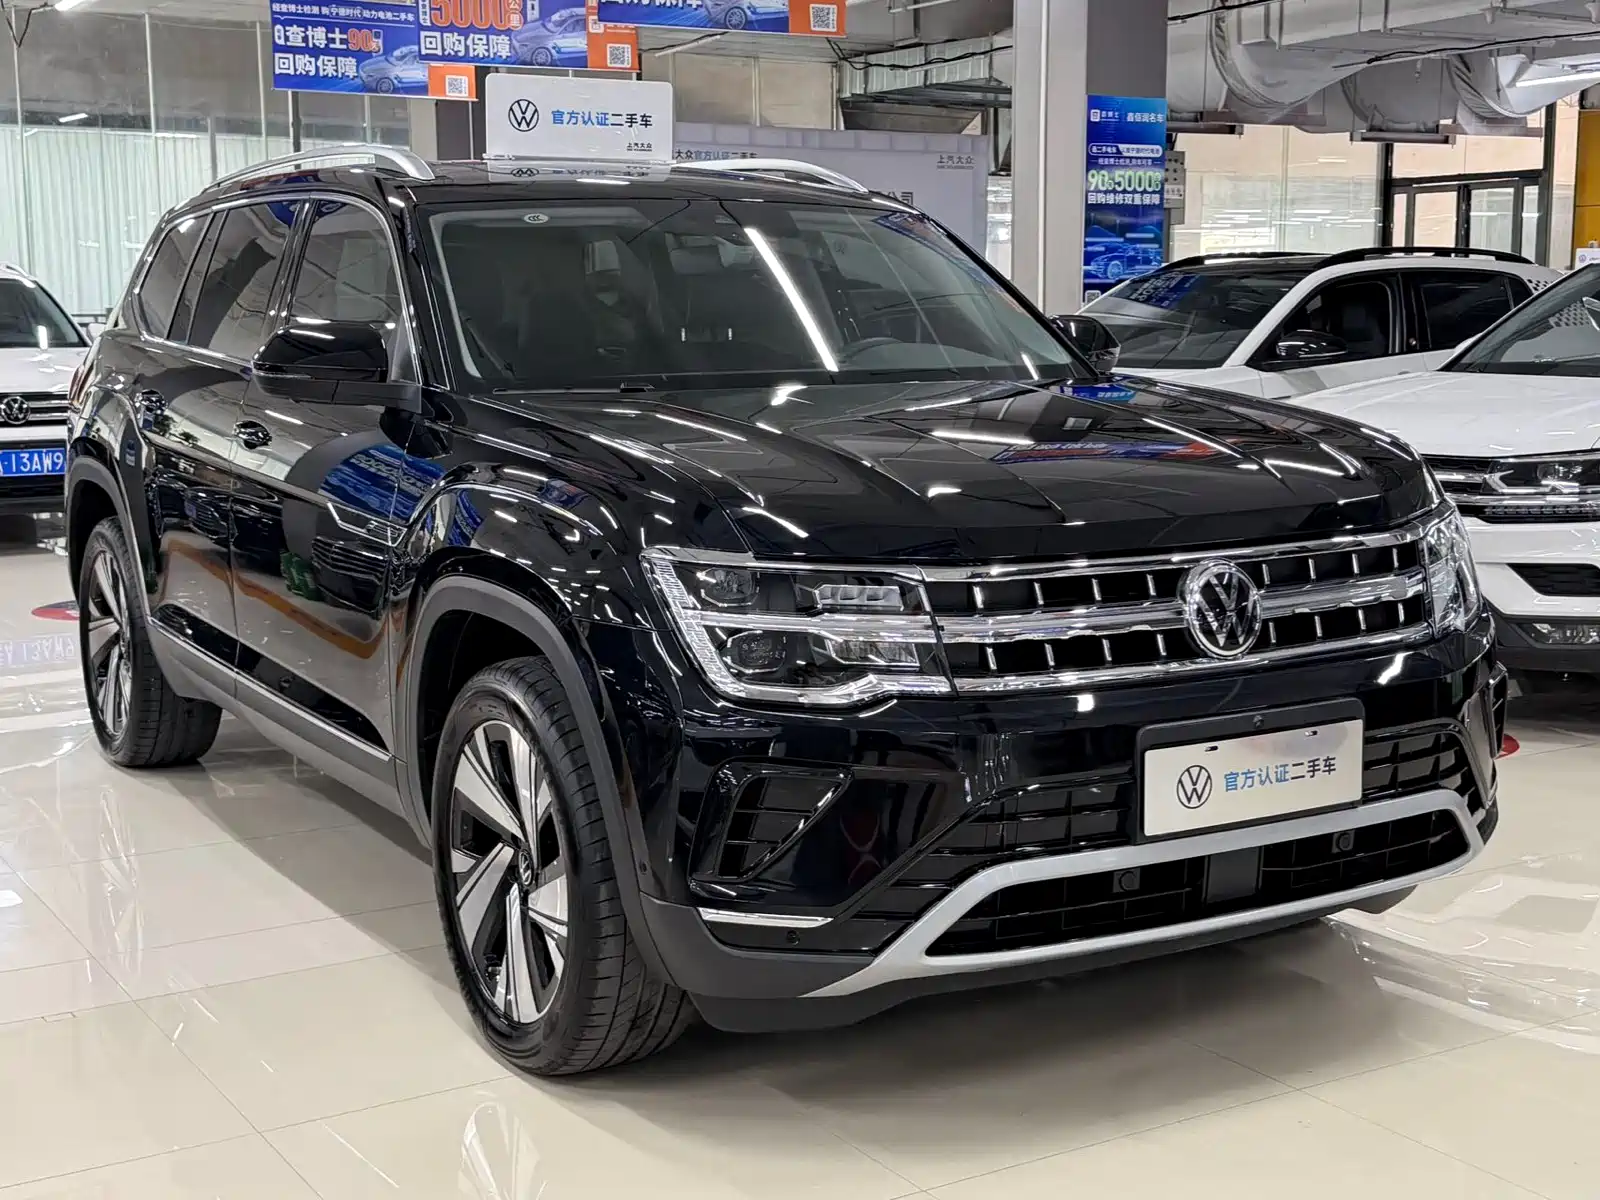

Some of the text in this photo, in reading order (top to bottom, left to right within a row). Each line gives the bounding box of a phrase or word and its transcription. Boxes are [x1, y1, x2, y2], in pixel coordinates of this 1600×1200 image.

[420, 31, 511, 59] 回购保障
[274, 52, 358, 79] 回购保障
[551, 109, 653, 128] 官方认证二手车
[937, 154, 974, 164] 上汽大众
[1223, 755, 1337, 793] 官方认证二手车
